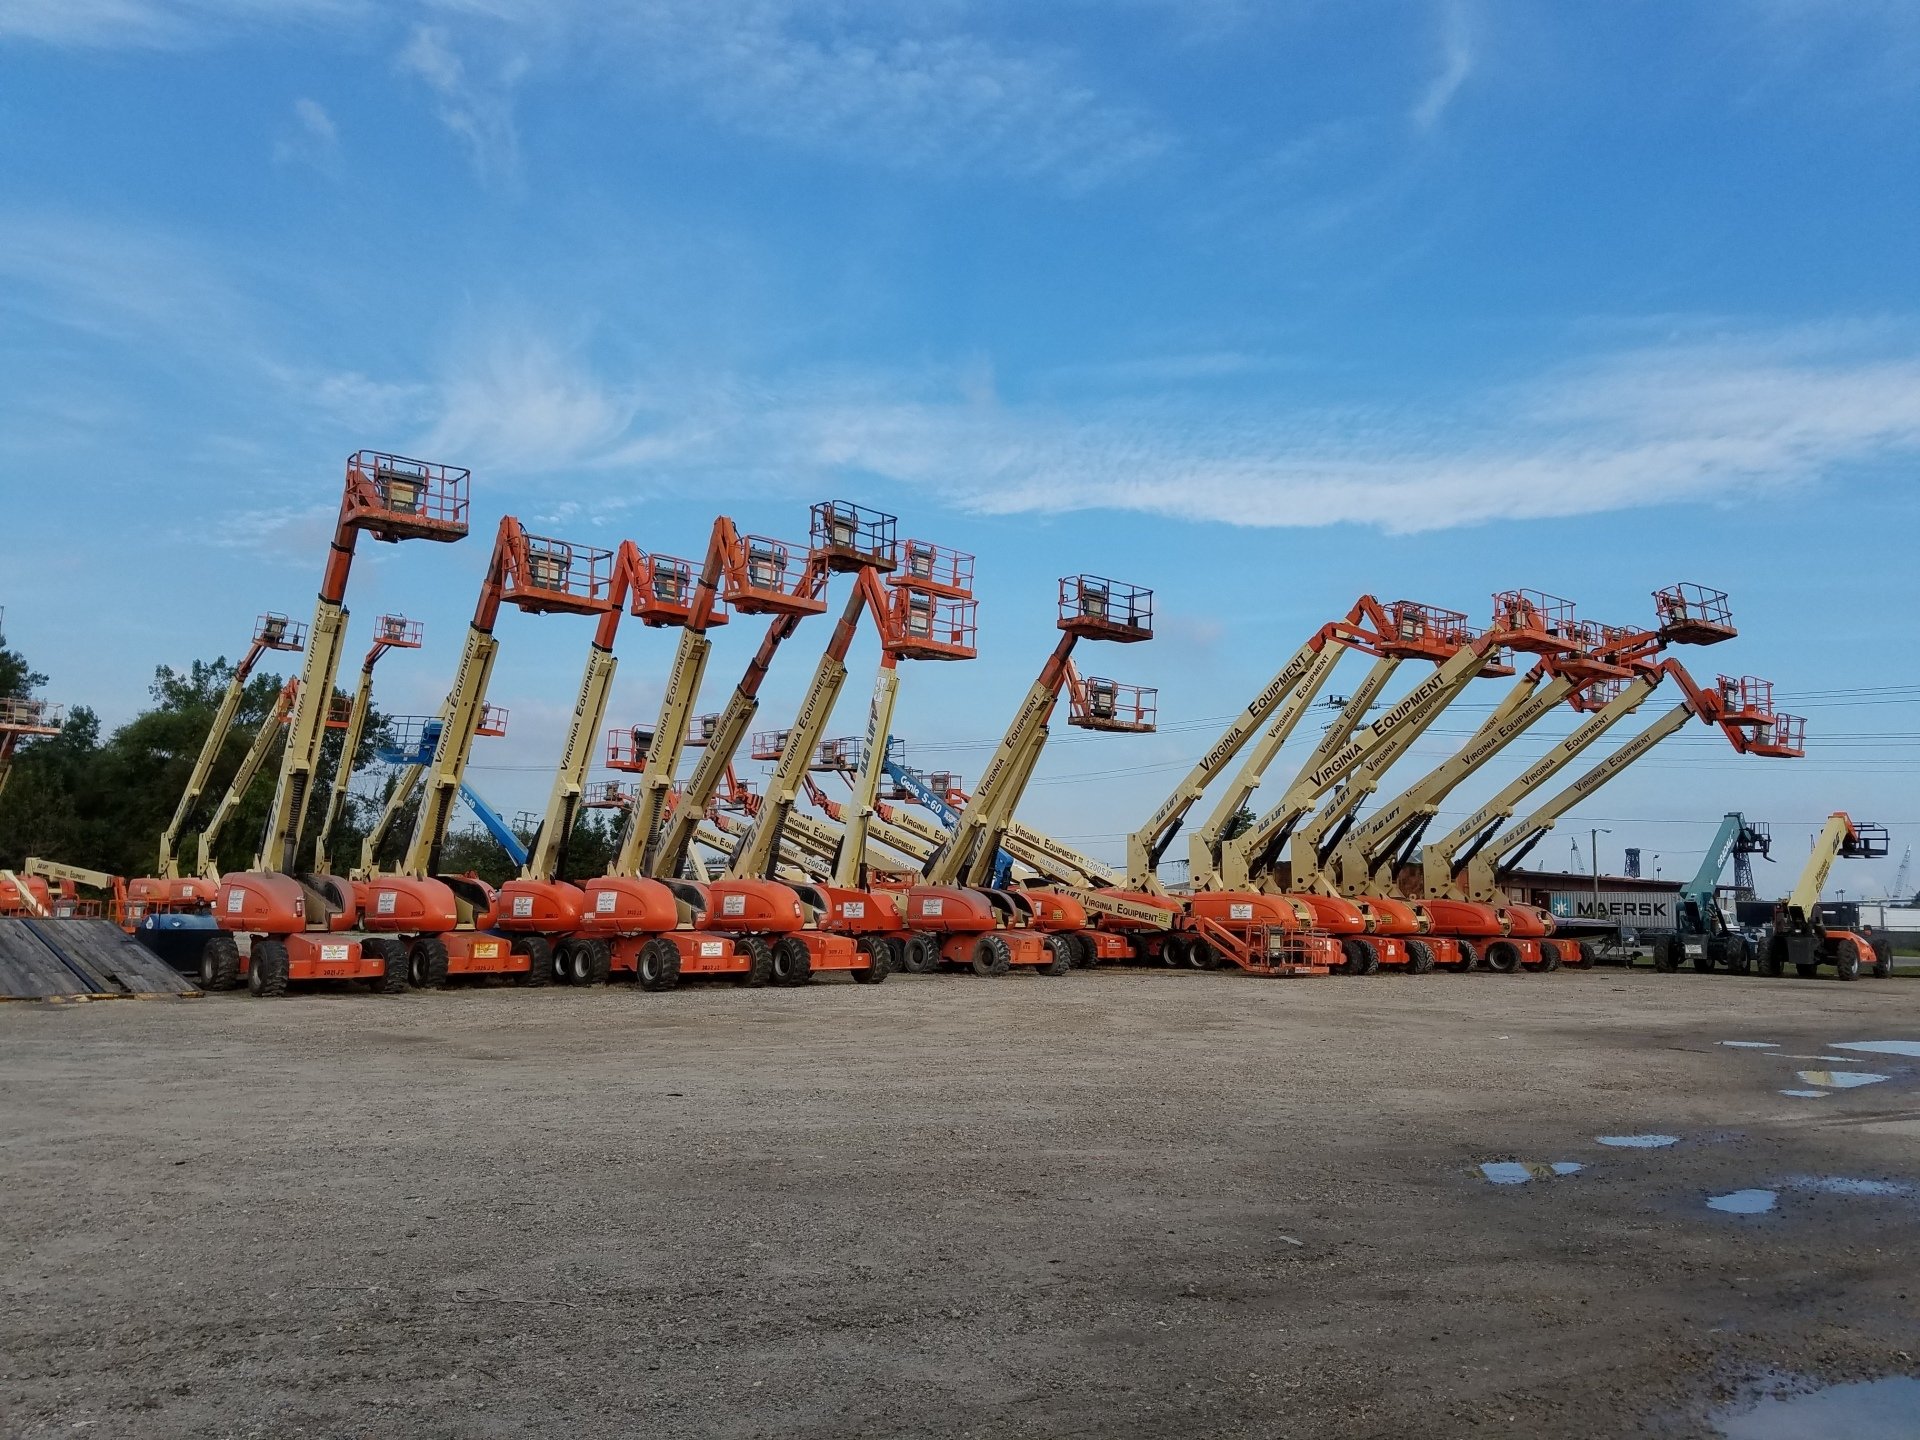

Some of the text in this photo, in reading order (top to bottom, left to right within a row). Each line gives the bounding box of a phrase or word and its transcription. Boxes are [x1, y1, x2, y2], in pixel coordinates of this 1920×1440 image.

[287, 606, 325, 749] VIRGINIA EQUIPMENT
[435, 636, 477, 763] VIRGINIA EQUIPMENT
[560, 648, 600, 771] VIRGINIA EQUIPMENT
[650, 634, 690, 764] VIRGINIA EQUIPMENT
[1198, 652, 1307, 772] VIRGINIA EQUIPMENT
[1268, 654, 1329, 738] VIRGINIA EQUIPMENT
[777, 665, 831, 780] VIRGINIA EQUIPMENT
[1309, 743, 1364, 788] VIRGINIA
[1370, 673, 1445, 738] EQUIPMENT
[1318, 676, 1377, 755] VIRGINIA EQUIPMENT
[1462, 698, 1545, 766] VIRGINIA EQUIPMENT
[230, 709, 278, 790] VIRGINIA EQUIPMENT
[686, 694, 742, 797] VIRGINIA EQUIPMENT
[978, 694, 1039, 797] VIRGINIA EQUIPMENT
[1366, 740, 1398, 772] VIRGINIA
[1520, 713, 1610, 787] VIRGINIA EQUIPMENT
[1574, 733, 1652, 792] VIRGINIA EQUIPMENT
[633, 790, 646, 818] LIFT
[901, 775, 943, 814] Genie S-60
[1155, 793, 1180, 824] JLG LIFT
[1324, 787, 1352, 821] JLG LIFT
[696, 829, 717, 843] IRGINIA
[788, 816, 840, 847] IRGINIA EQUIPME
[902, 813, 928, 834] VIRGINIA
[1257, 803, 1287, 835] JLG LIFT
[1357, 822, 1371, 836] LIFT
[1372, 806, 1400, 835] JLG LIFT
[1458, 809, 1488, 838] JLG LIFT
[1503, 821, 1532, 846] JLG LIFT
[805, 839, 836, 857] EQUIPMEN
[883, 830, 917, 853] EQUIPMENT
[1005, 838, 1036, 862] EQUIPMENT
[1015, 824, 1113, 879] VIRGINIA EQUIPMENT 1200SJP
[780, 845, 799, 859] PMENT
[803, 857, 830, 874] 1200SJP
[1083, 895, 1113, 912] VIRGINIA
[1116, 903, 1159, 923] EQUIPMENT
[1577, 902, 1667, 917] MAERSK
